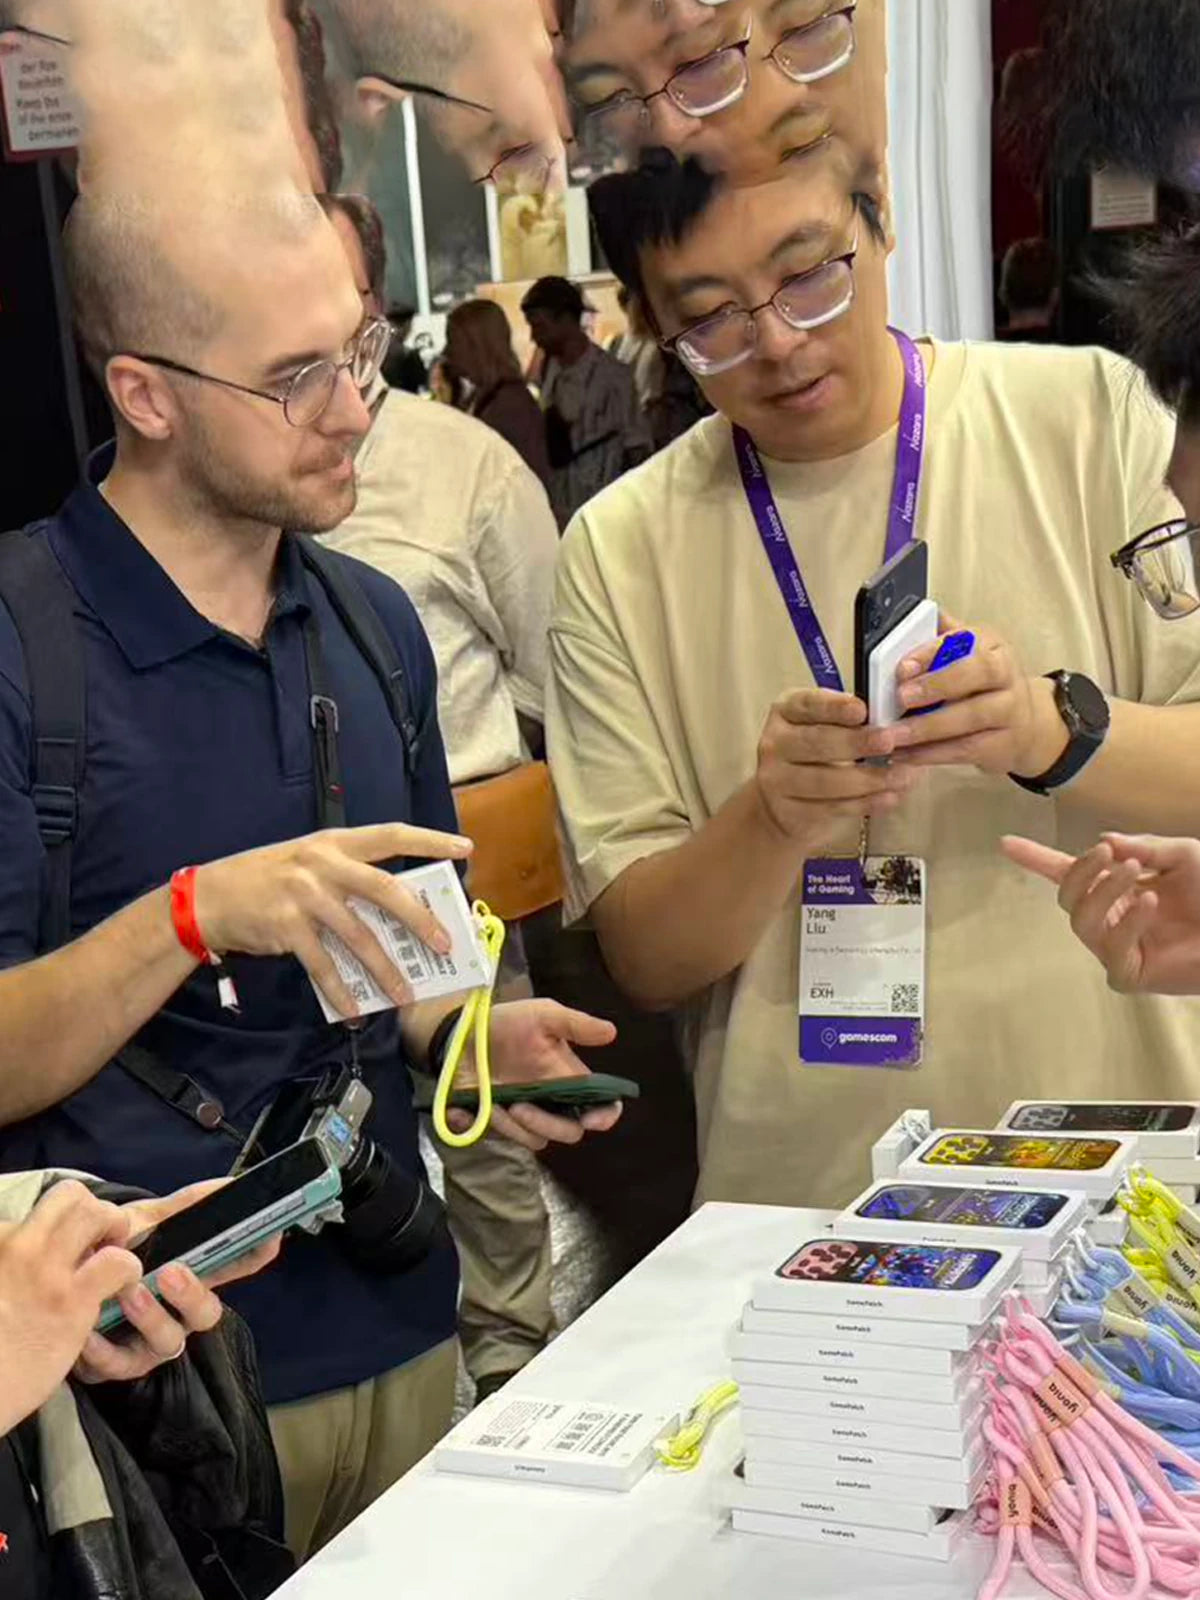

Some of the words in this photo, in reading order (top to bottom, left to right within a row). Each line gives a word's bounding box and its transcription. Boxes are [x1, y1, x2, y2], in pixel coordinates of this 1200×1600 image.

[904, 414, 922, 451] Nazara
[896, 482, 916, 522] Nazara
[813, 636, 837, 675] Nazara
[807, 874, 823, 884] The
[825, 874, 851, 884] Heart
[818, 885, 856, 896] Gaming
[807, 908, 836, 921] Yang
[810, 987, 834, 999] EXH
[839, 1033, 898, 1044] gamescom
[1171, 1250, 1197, 1279] yonia
[1123, 1285, 1149, 1310] yonia
[1048, 1382, 1080, 1413] yonia
[1008, 1483, 1019, 1518] yonia
